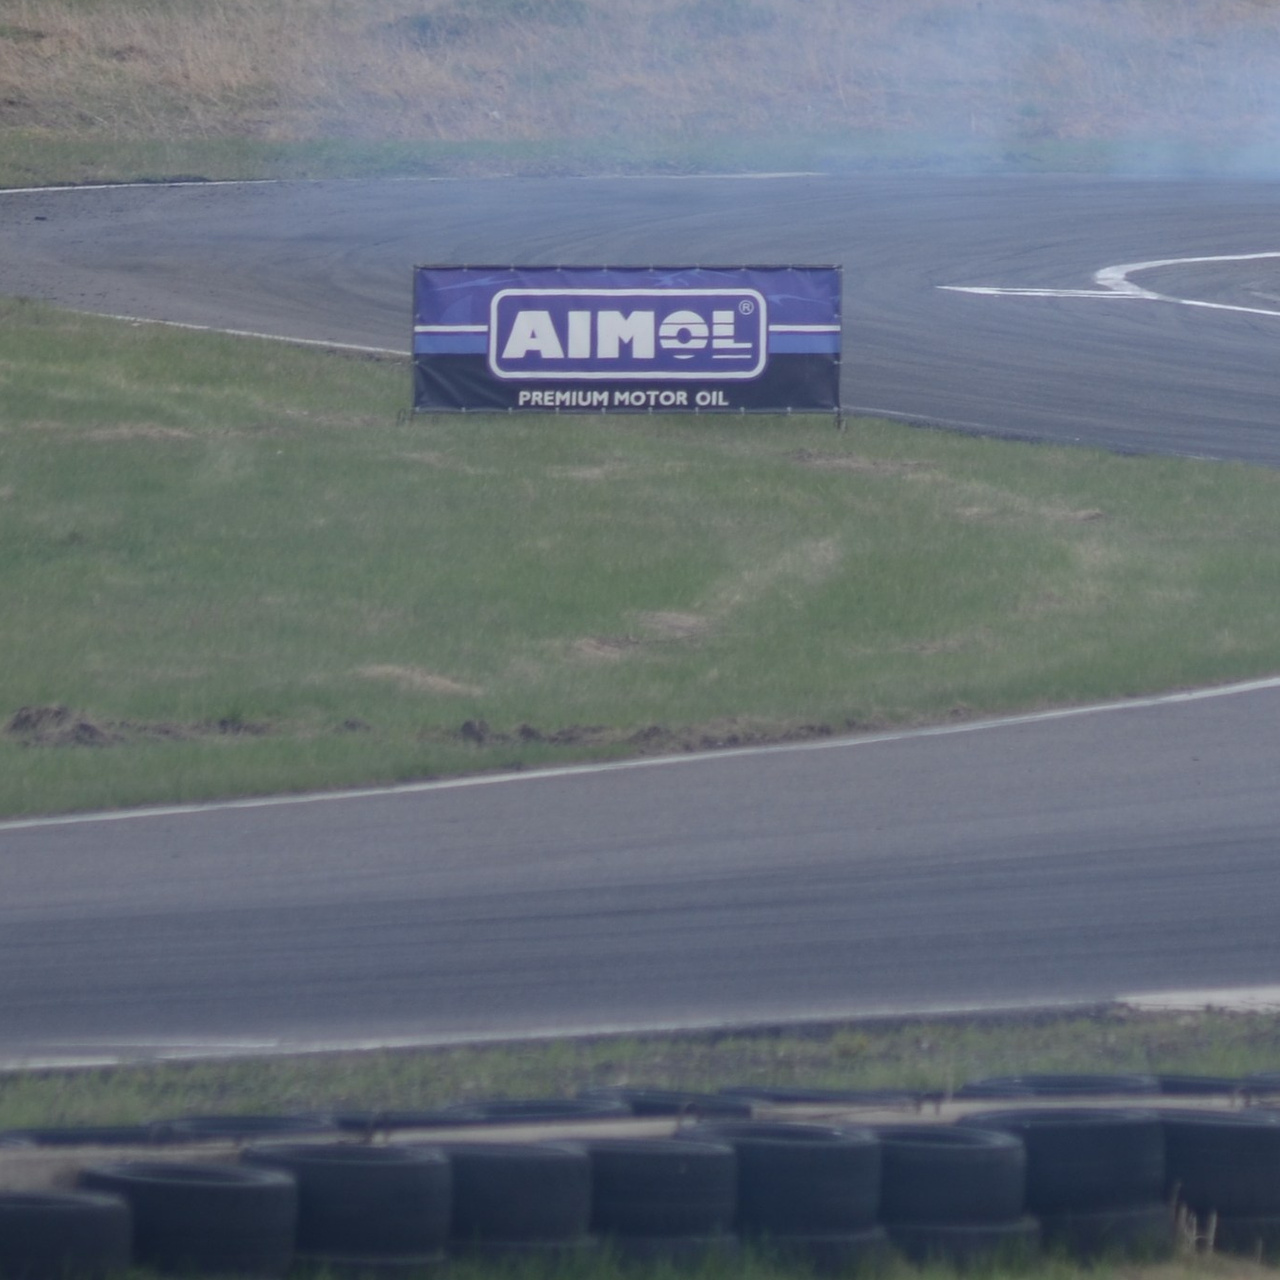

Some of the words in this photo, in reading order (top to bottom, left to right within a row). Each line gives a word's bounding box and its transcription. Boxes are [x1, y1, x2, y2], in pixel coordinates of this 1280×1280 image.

[502, 310, 752, 359] AIMOL
[518, 391, 609, 406] PREMIUM
[613, 391, 688, 406] MOTOR
[695, 391, 729, 406] OIL
